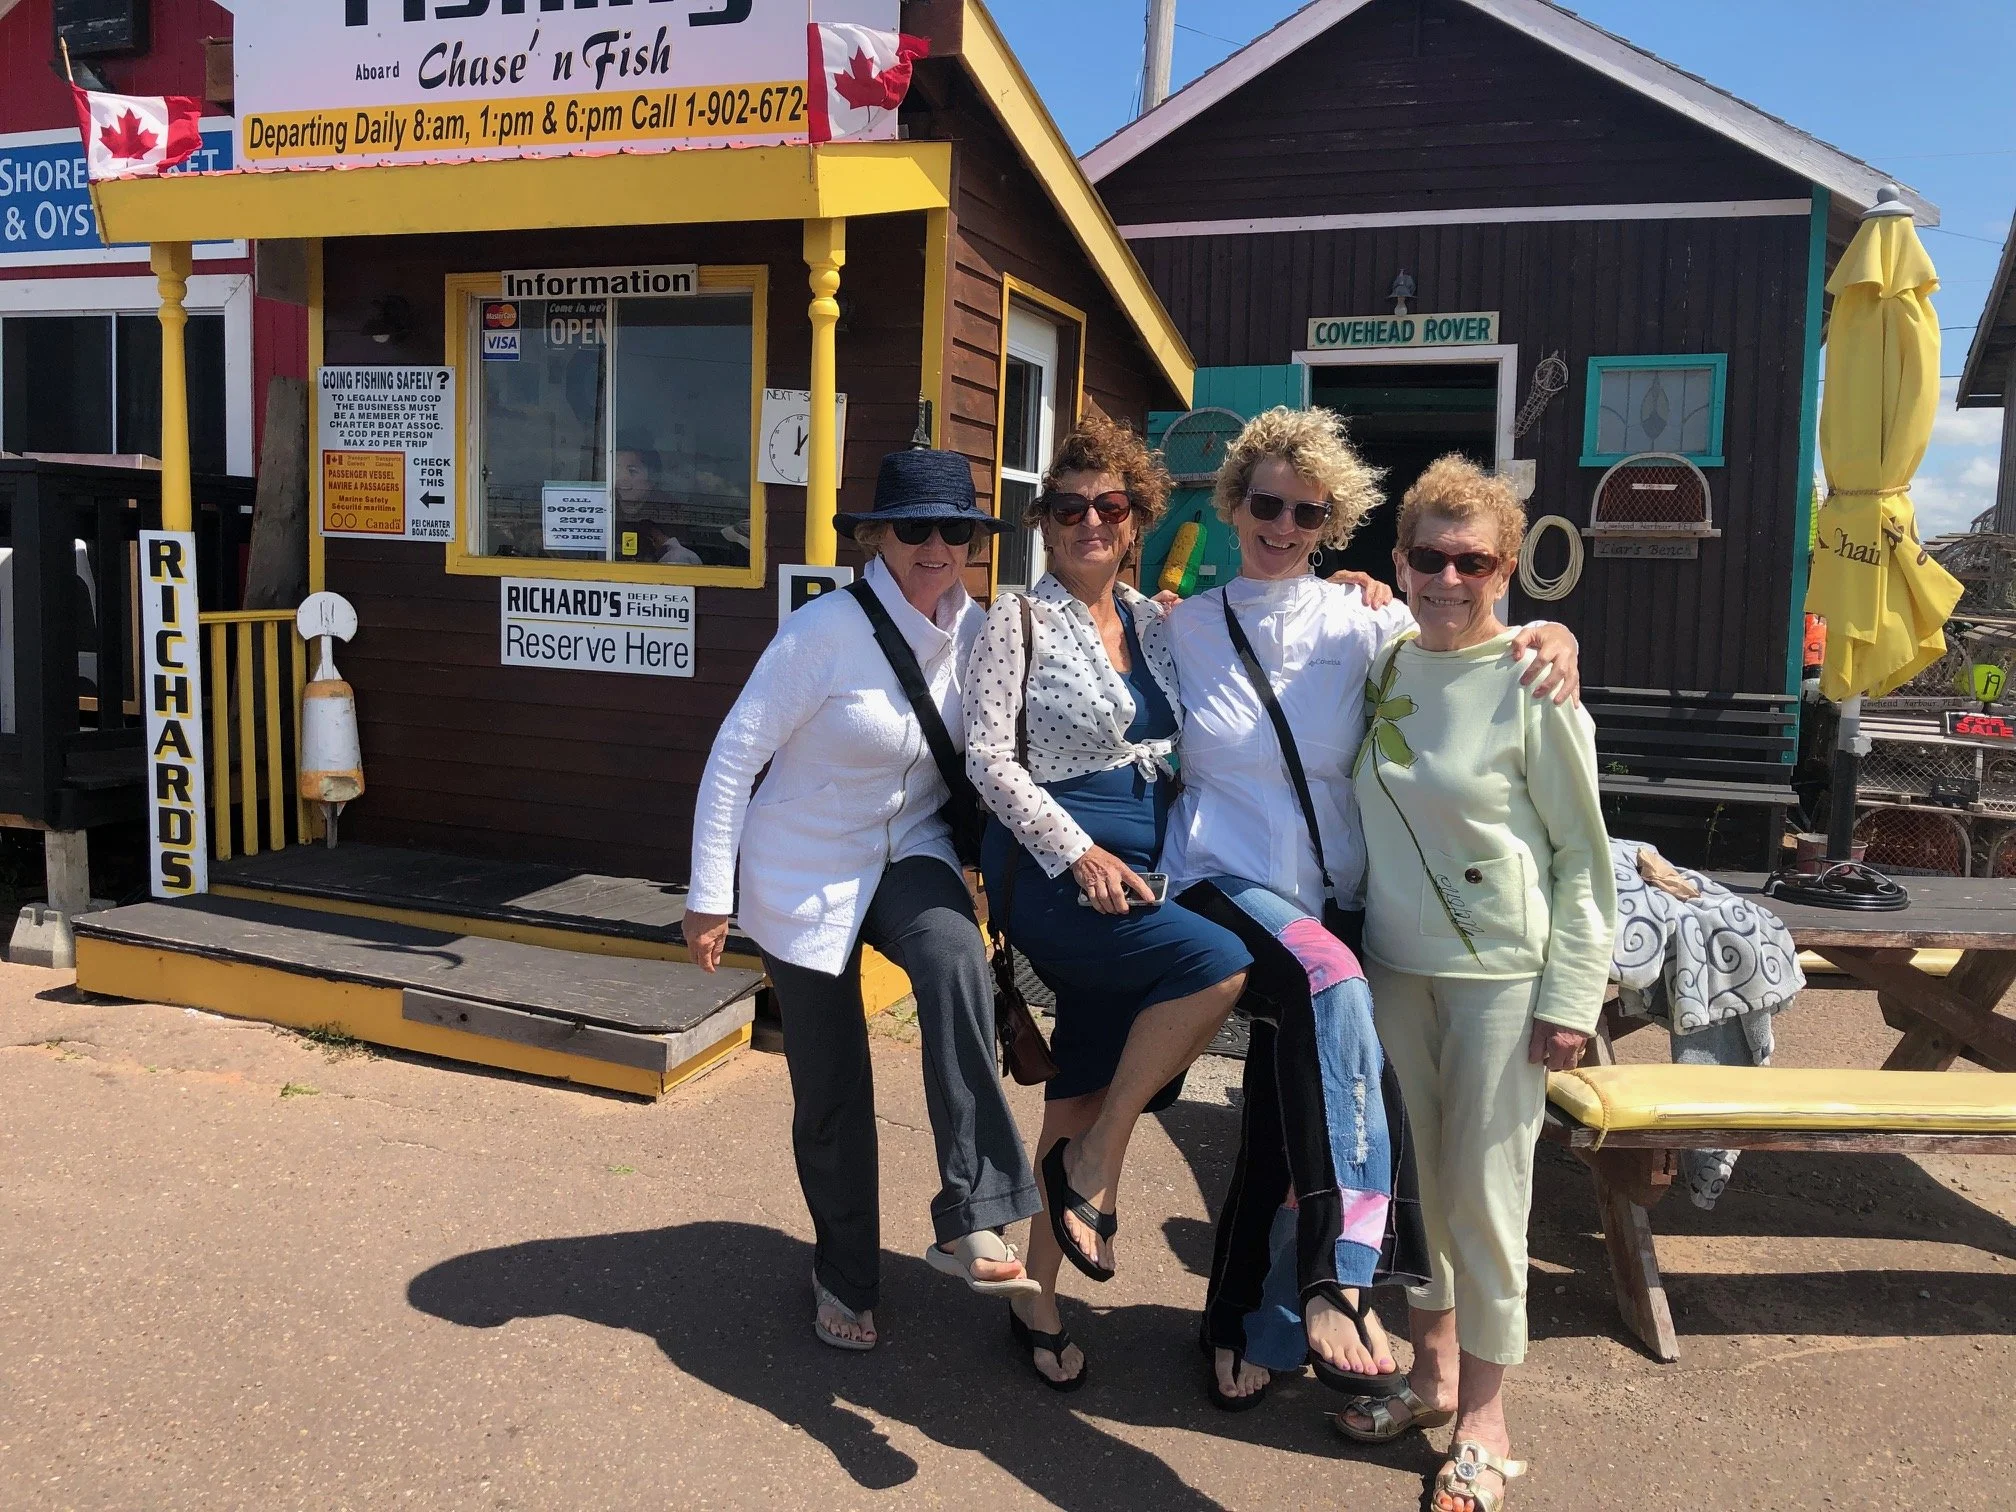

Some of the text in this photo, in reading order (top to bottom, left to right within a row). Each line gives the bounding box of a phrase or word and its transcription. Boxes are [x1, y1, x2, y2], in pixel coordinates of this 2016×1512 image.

[582, 25, 672, 90] Fish
[355, 61, 400, 81] Aboard
[249, 85, 808, 154] Departing Daily 8:am, 1:pm & 6:pm Call 1-902-672-
[0, 158, 88, 197] SHORE
[5, 206, 27, 241] &
[506, 268, 691, 297] Information
[549, 303, 574, 314] Come
[486, 312, 516, 320] MasterCard
[550, 318, 607, 345] OPEN
[1316, 317, 1491, 345] COVEHEAD ROVER
[488, 336, 518, 350] VISA
[322, 371, 353, 390] GOING
[355, 371, 394, 390] FISHING
[396, 371, 434, 390] SAFELY
[331, 394, 442, 403] TO LEGALLY LAND COD
[766, 389, 793, 401] NEXT
[336, 403, 437, 412] THE BUSINESS MUST
[334, 412, 439, 421] BE A MEMBER OF THE
[329, 421, 444, 430] CHARTER BOAT ASSOC.
[348, 430, 368, 438] COD
[371, 430, 388, 438] PER
[393, 431, 433, 439] PERSON
[344, 439, 365, 447] MAX
[405, 440, 428, 448] TRIP
[413, 457, 451, 467] CHECK
[328, 469, 395, 480] PASSENGER VESSEL
[421, 468, 443, 477] FOR
[328, 481, 352, 490] NAVIRE
[360, 482, 400, 491] PASSAGERS
[419, 478, 445, 487] THIS
[339, 495, 389, 504] Marine Safety
[363, 504, 396, 512] maritime
[366, 518, 400, 530] Canada
[411, 519, 450, 529] PEI CHARTER
[559, 516, 595, 524] 2376
[411, 528, 450, 538] BOAT ASSOC.
[1600, 542, 1643, 556] Liar's
[507, 585, 689, 618] RICHARD'S DEEP SEA
[627, 601, 690, 623] Fishing
[507, 624, 689, 669] Reserve Here
[1982, 671, 2001, 697] 19
[148, 538, 196, 893] RICHARDS
[1962, 716, 2006, 727] FOR
[1956, 723, 2014, 738] SALE
